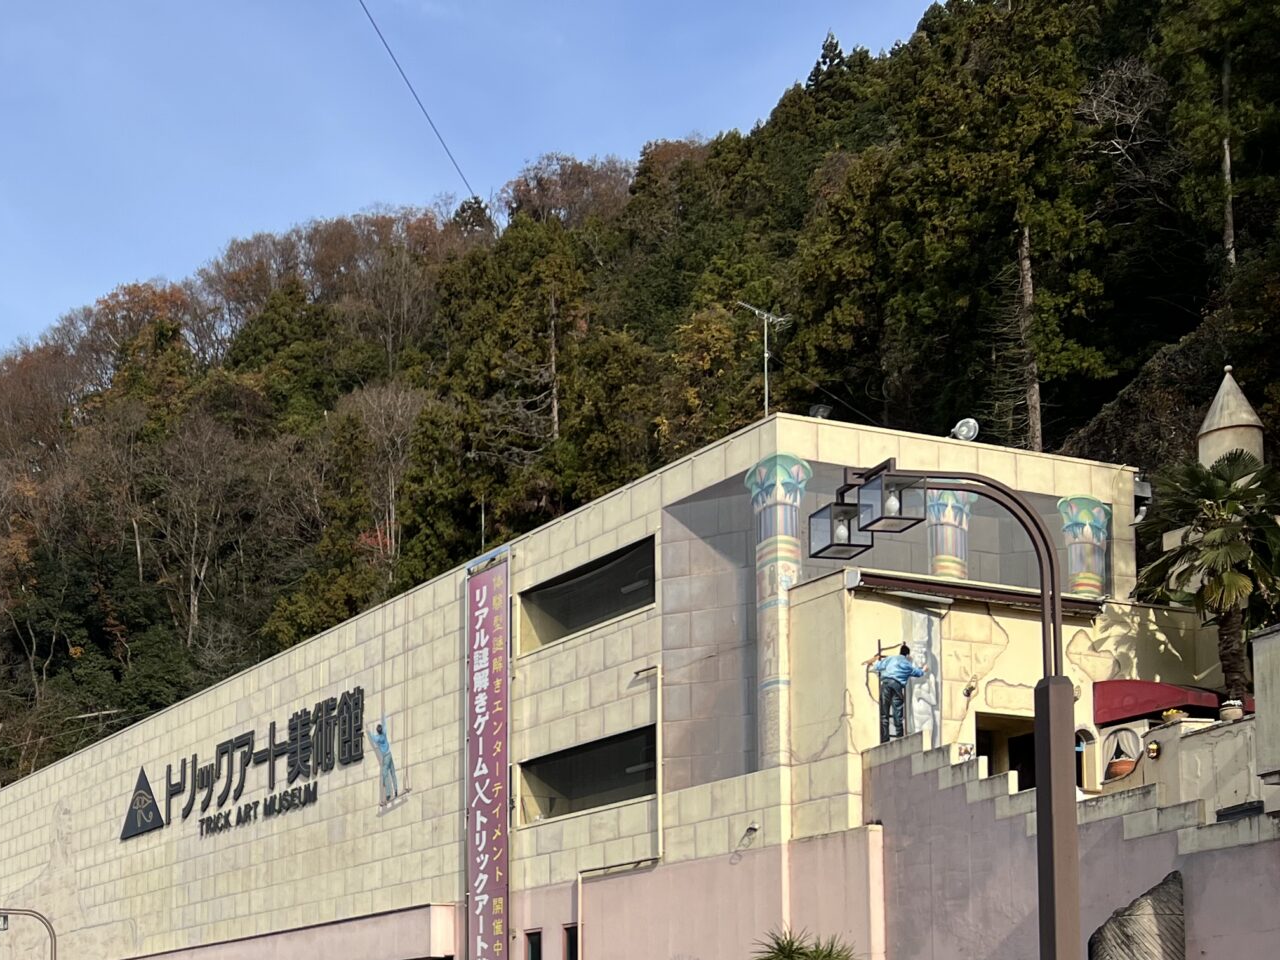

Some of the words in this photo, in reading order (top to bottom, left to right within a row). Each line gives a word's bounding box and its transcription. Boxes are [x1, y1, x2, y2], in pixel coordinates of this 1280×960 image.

[165, 686, 364, 826] トリックアート美術館
[198, 809, 232, 836] TRICK
[235, 800, 260, 826] ART
[263, 780, 318, 818] MUSEUM
[492, 897, 503, 956] 開催中
